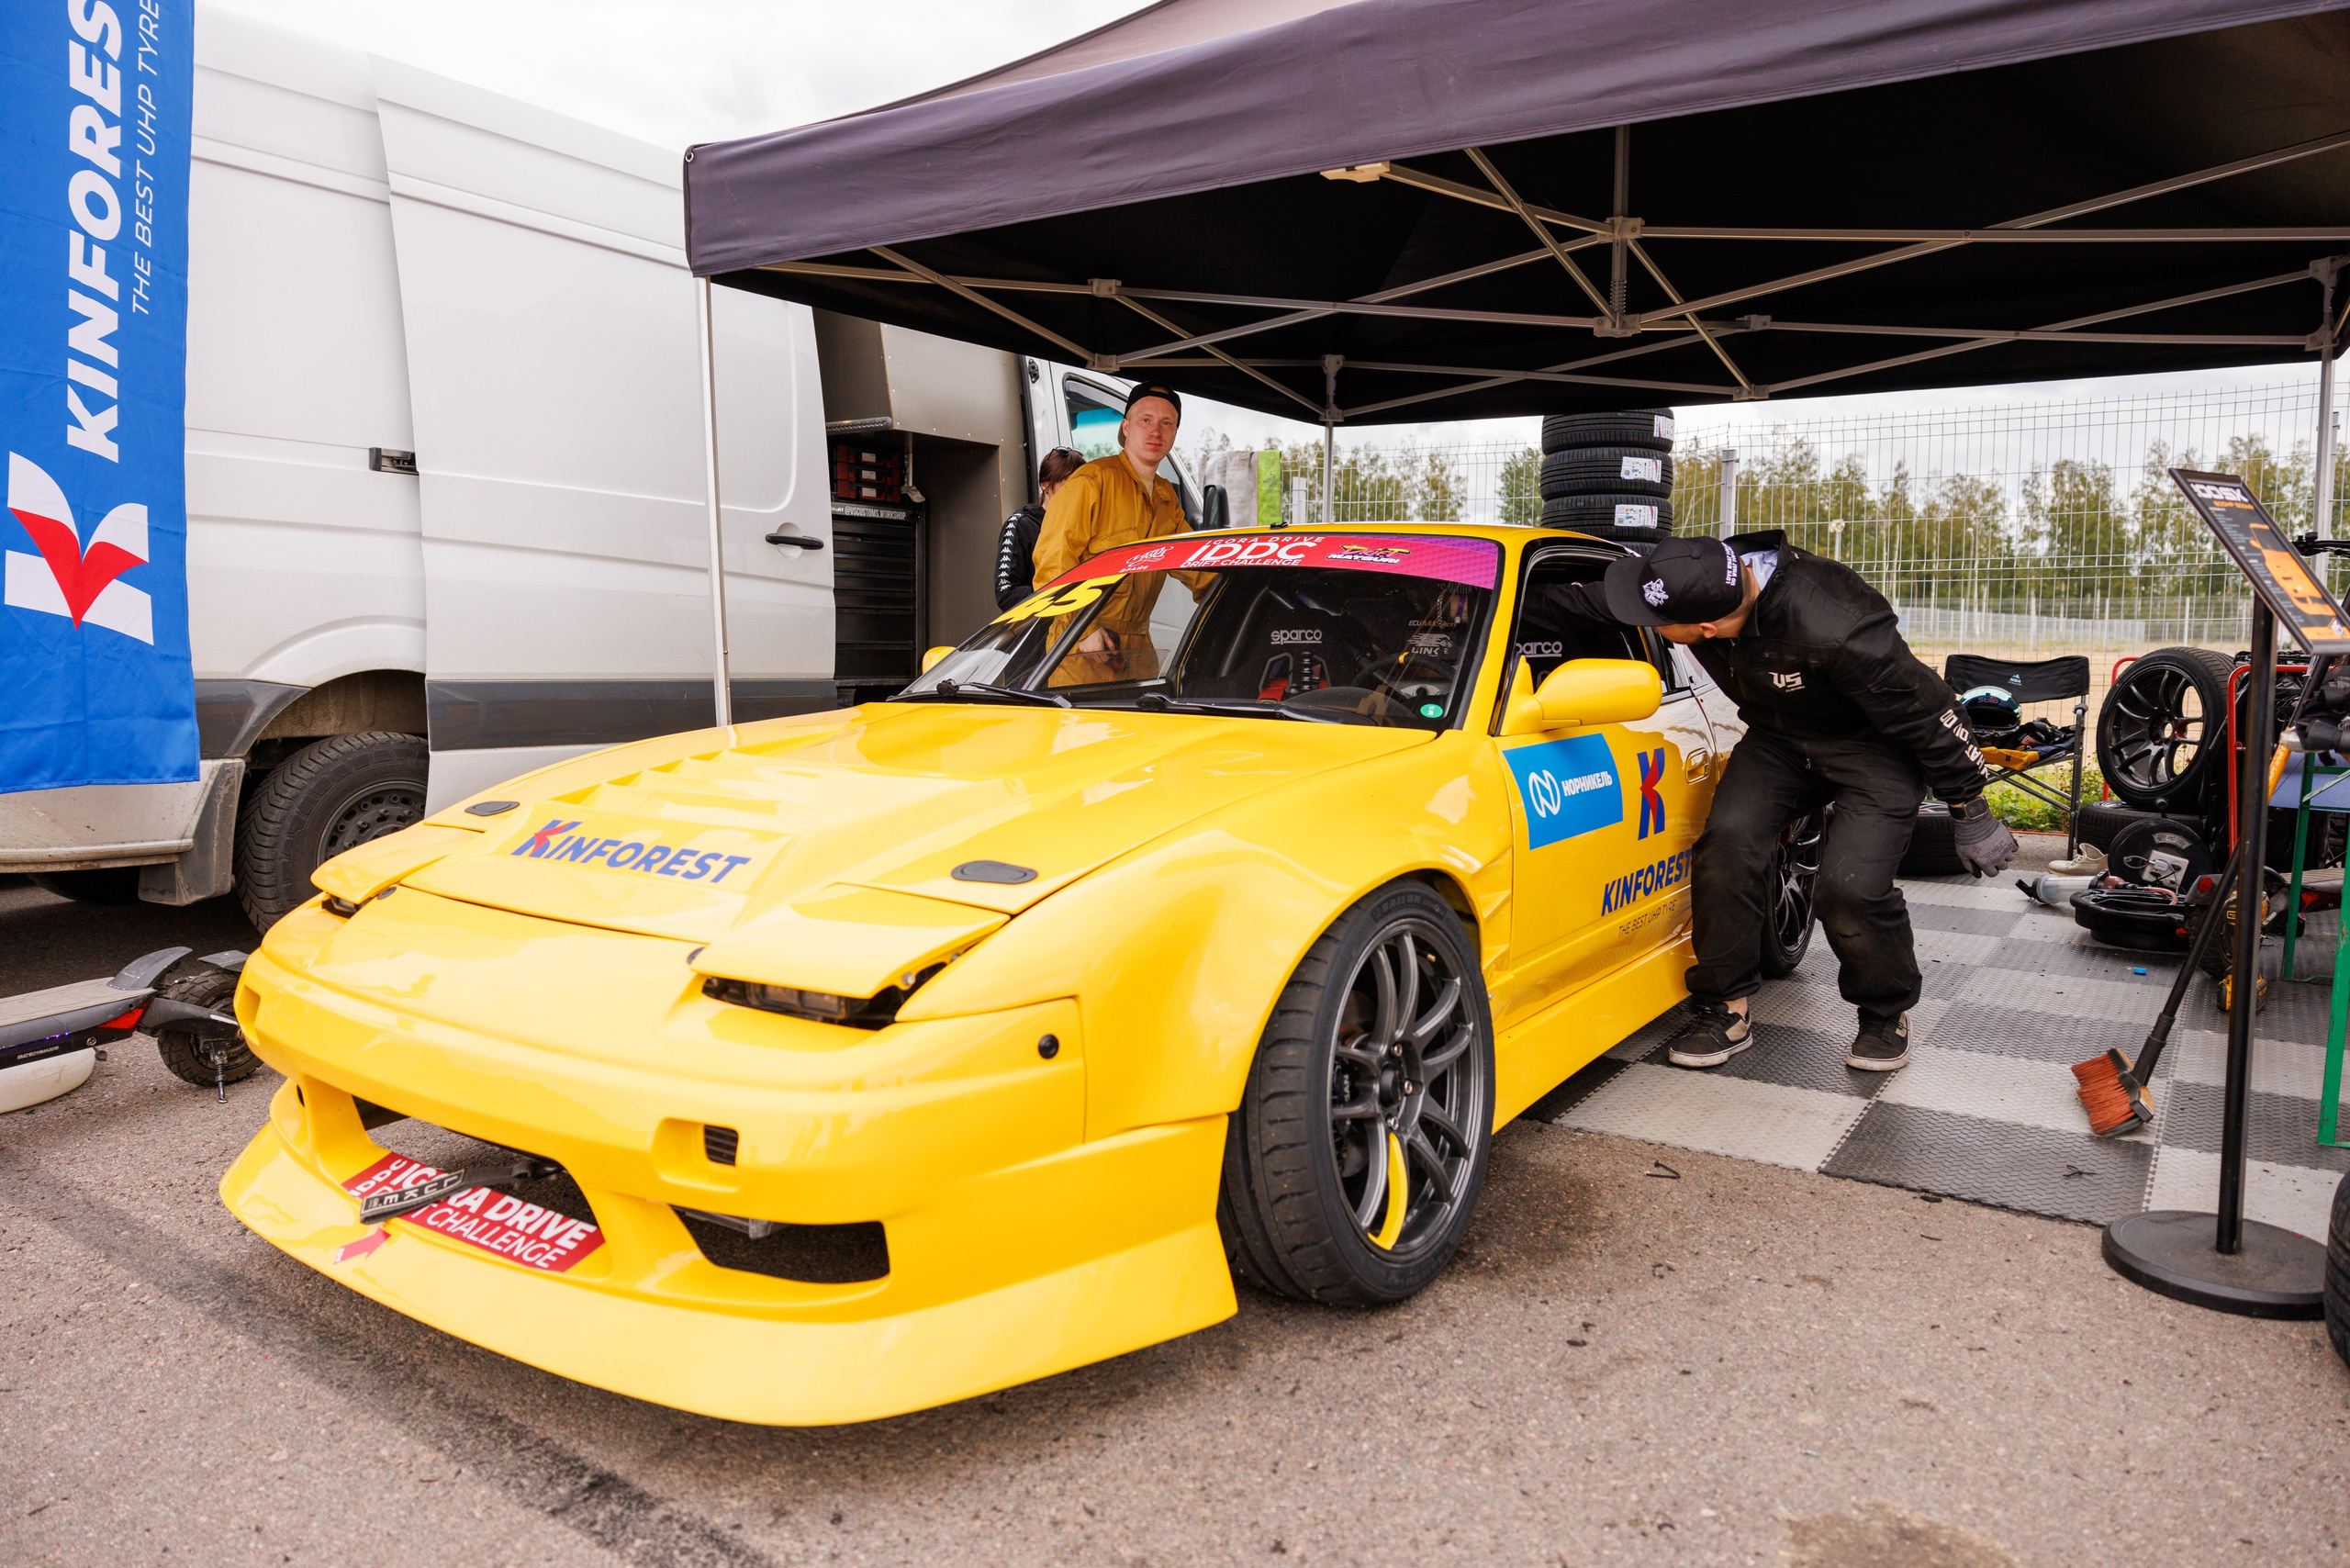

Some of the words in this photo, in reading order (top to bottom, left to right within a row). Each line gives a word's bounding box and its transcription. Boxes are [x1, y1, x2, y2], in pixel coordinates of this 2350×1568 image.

[138, 0, 160, 76] TYRE
[137, 84, 157, 156] UHP
[68, 0, 121, 464] KINFORES
[135, 160, 154, 248] BEST
[132, 252, 151, 315] THE
[1180, 559, 1225, 568] DRIFT
[1225, 558, 1302, 566] CHALLENGE
[1187, 542, 1317, 562] IDDC
[1205, 536, 1259, 545] IGORA
[1270, 629, 1323, 644] sparco
[1515, 641, 1563, 655] parco
[1940, 709, 1958, 728] DO
[1561, 770, 1613, 797] НОРНИКЕЛЬ
[510, 820, 752, 883] KINFOREST
[1601, 848, 1692, 916] KINFOREST
[1618, 921, 1631, 937] THE
[1631, 913, 1648, 932] BEST
[389, 1162, 484, 1214] IGRA
[486, 1194, 597, 1250] DRIVE
[426, 1207, 566, 1269] CHALLENGE
